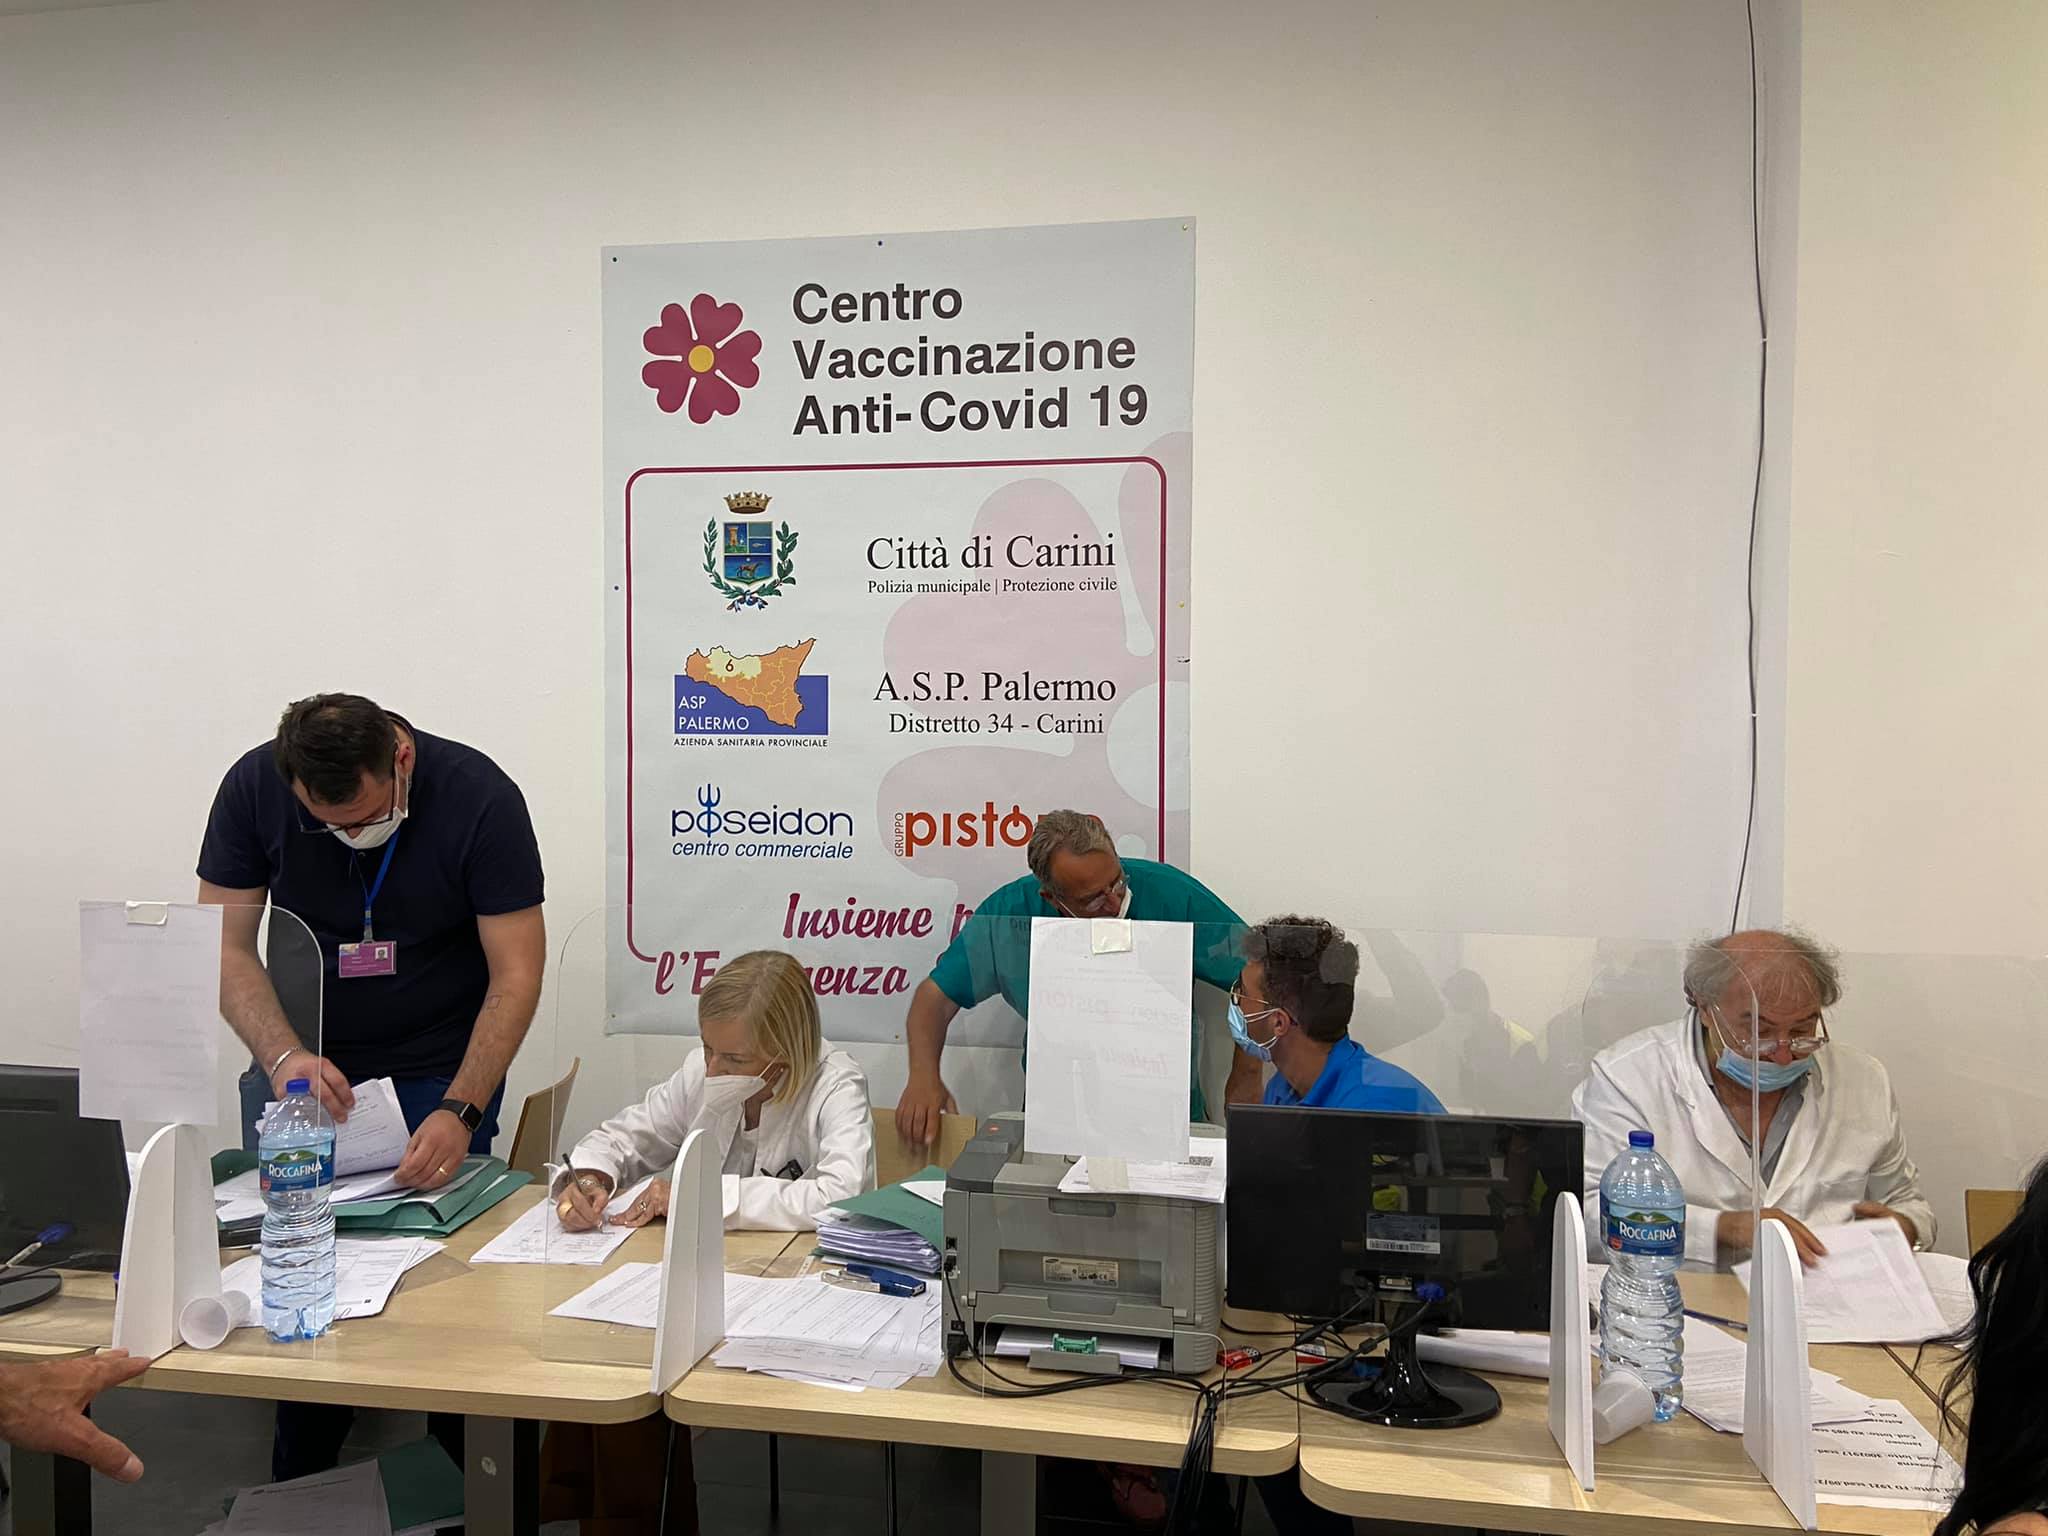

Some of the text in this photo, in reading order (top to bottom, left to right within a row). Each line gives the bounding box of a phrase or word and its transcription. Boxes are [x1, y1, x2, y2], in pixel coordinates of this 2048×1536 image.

[793, 283, 962, 324] Centro
[792, 331, 1135, 379] Vaccinazione
[793, 384, 1147, 435] Anti-Covid 19
[867, 533, 1115, 569] Città di Carini
[869, 580, 913, 593] Polizia
[918, 579, 990, 595] municipale
[1003, 578, 1074, 591] Protezione
[1079, 577, 1117, 592] civile
[725, 659, 735, 672] 6
[873, 671, 1116, 701] A.S.P. Palermo
[679, 696, 706, 709] ASP
[678, 716, 750, 731] PALERMO
[890, 713, 980, 733] Distretto
[988, 714, 1013, 733] 34
[1037, 713, 1104, 734] Carini
[769, 739, 827, 747] PROVINCIALE
[672, 790, 853, 838] poseidon
[894, 812, 904, 856] GRUPPO
[673, 841, 853, 858] centro commerciale
[783, 893, 933, 939] Insieme
[269, 1160, 322, 1178] ROCCAFINA
[1619, 1221, 1677, 1240] ROCCAFINA
